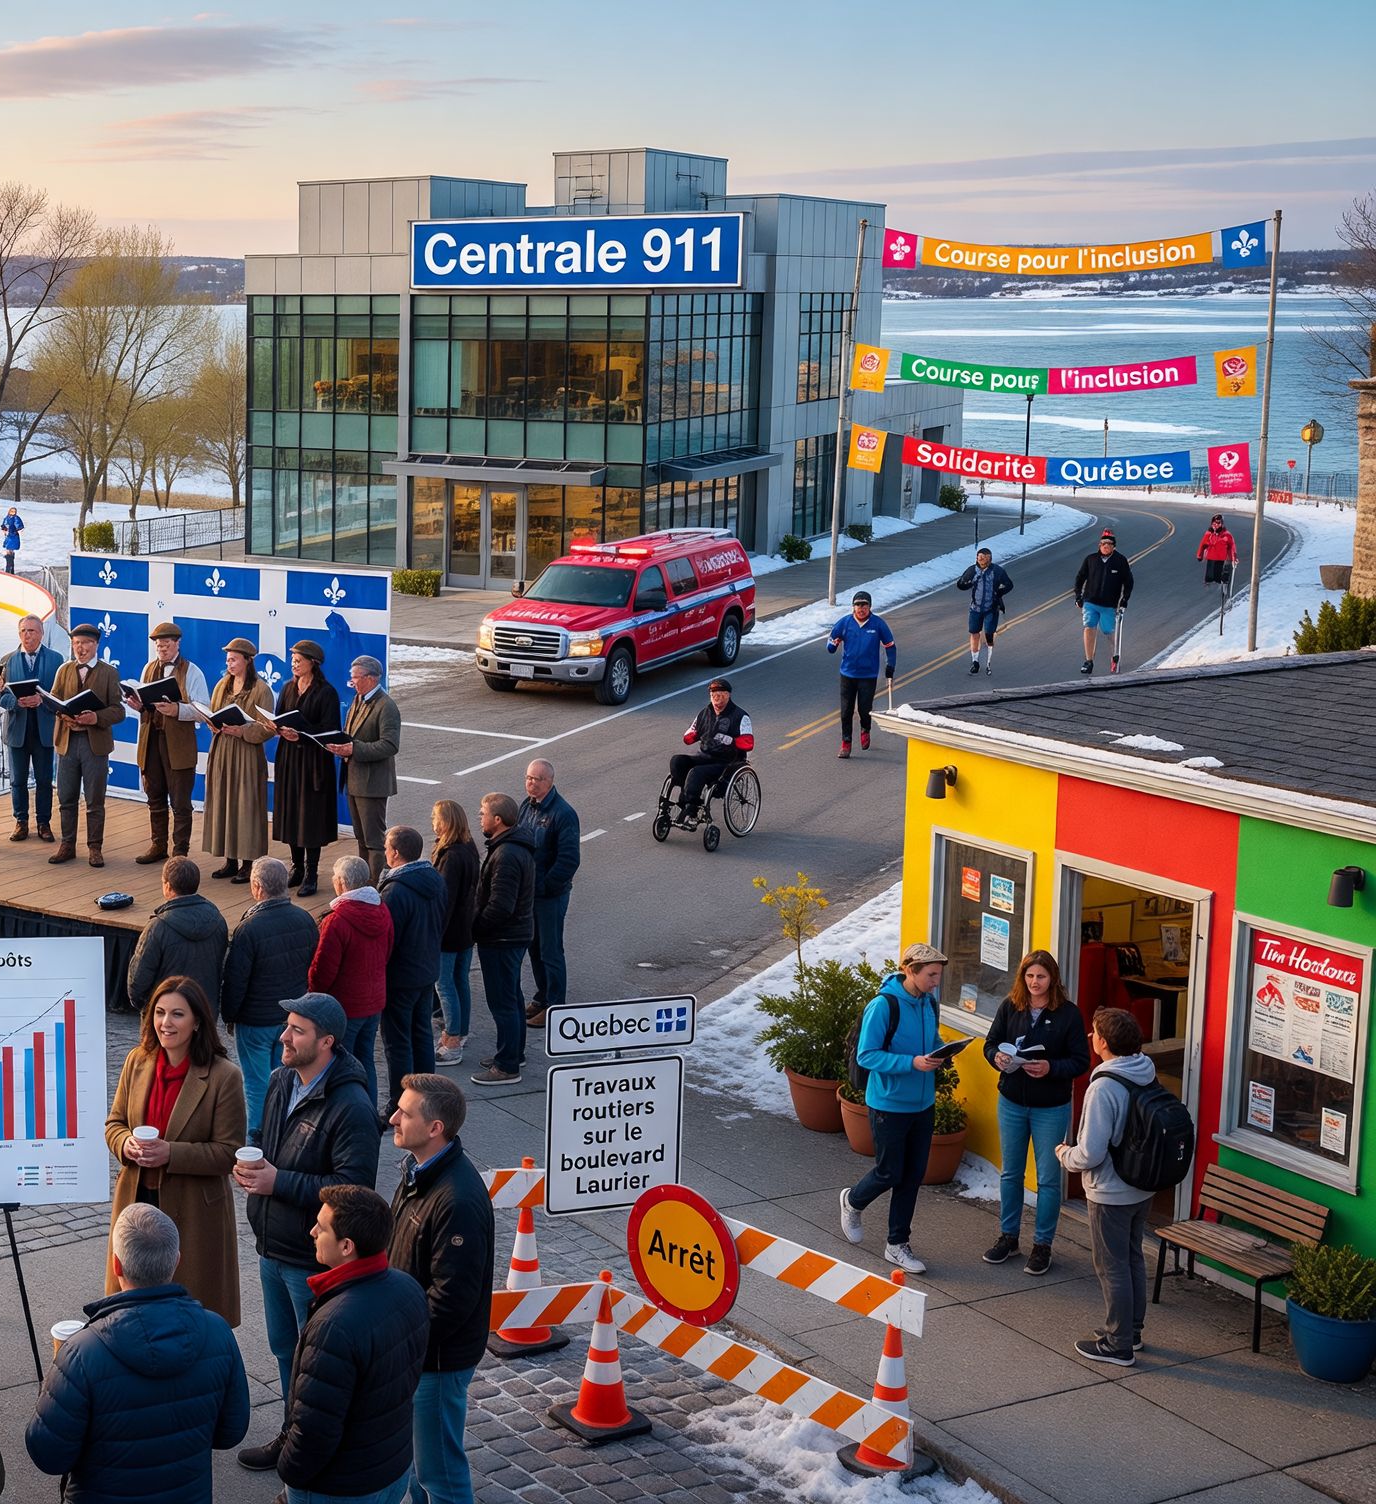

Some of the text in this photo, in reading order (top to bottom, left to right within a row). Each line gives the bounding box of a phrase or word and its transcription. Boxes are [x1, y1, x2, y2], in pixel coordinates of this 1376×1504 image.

[424, 227, 721, 275] Centrale 911
[935, 243, 1196, 274] Course pour l'inclusion
[911, 359, 984, 386] Course
[1061, 366, 1179, 389] l'inclusion
[559, 1013, 651, 1044] Quebec
[572, 1076, 656, 1097] Travaux
[573, 1100, 654, 1121] routiers
[583, 1122, 642, 1145] sur le
[561, 1143, 664, 1172] boulevard
[576, 1171, 650, 1194] Laurier
[647, 1229, 716, 1281] Arrêt
